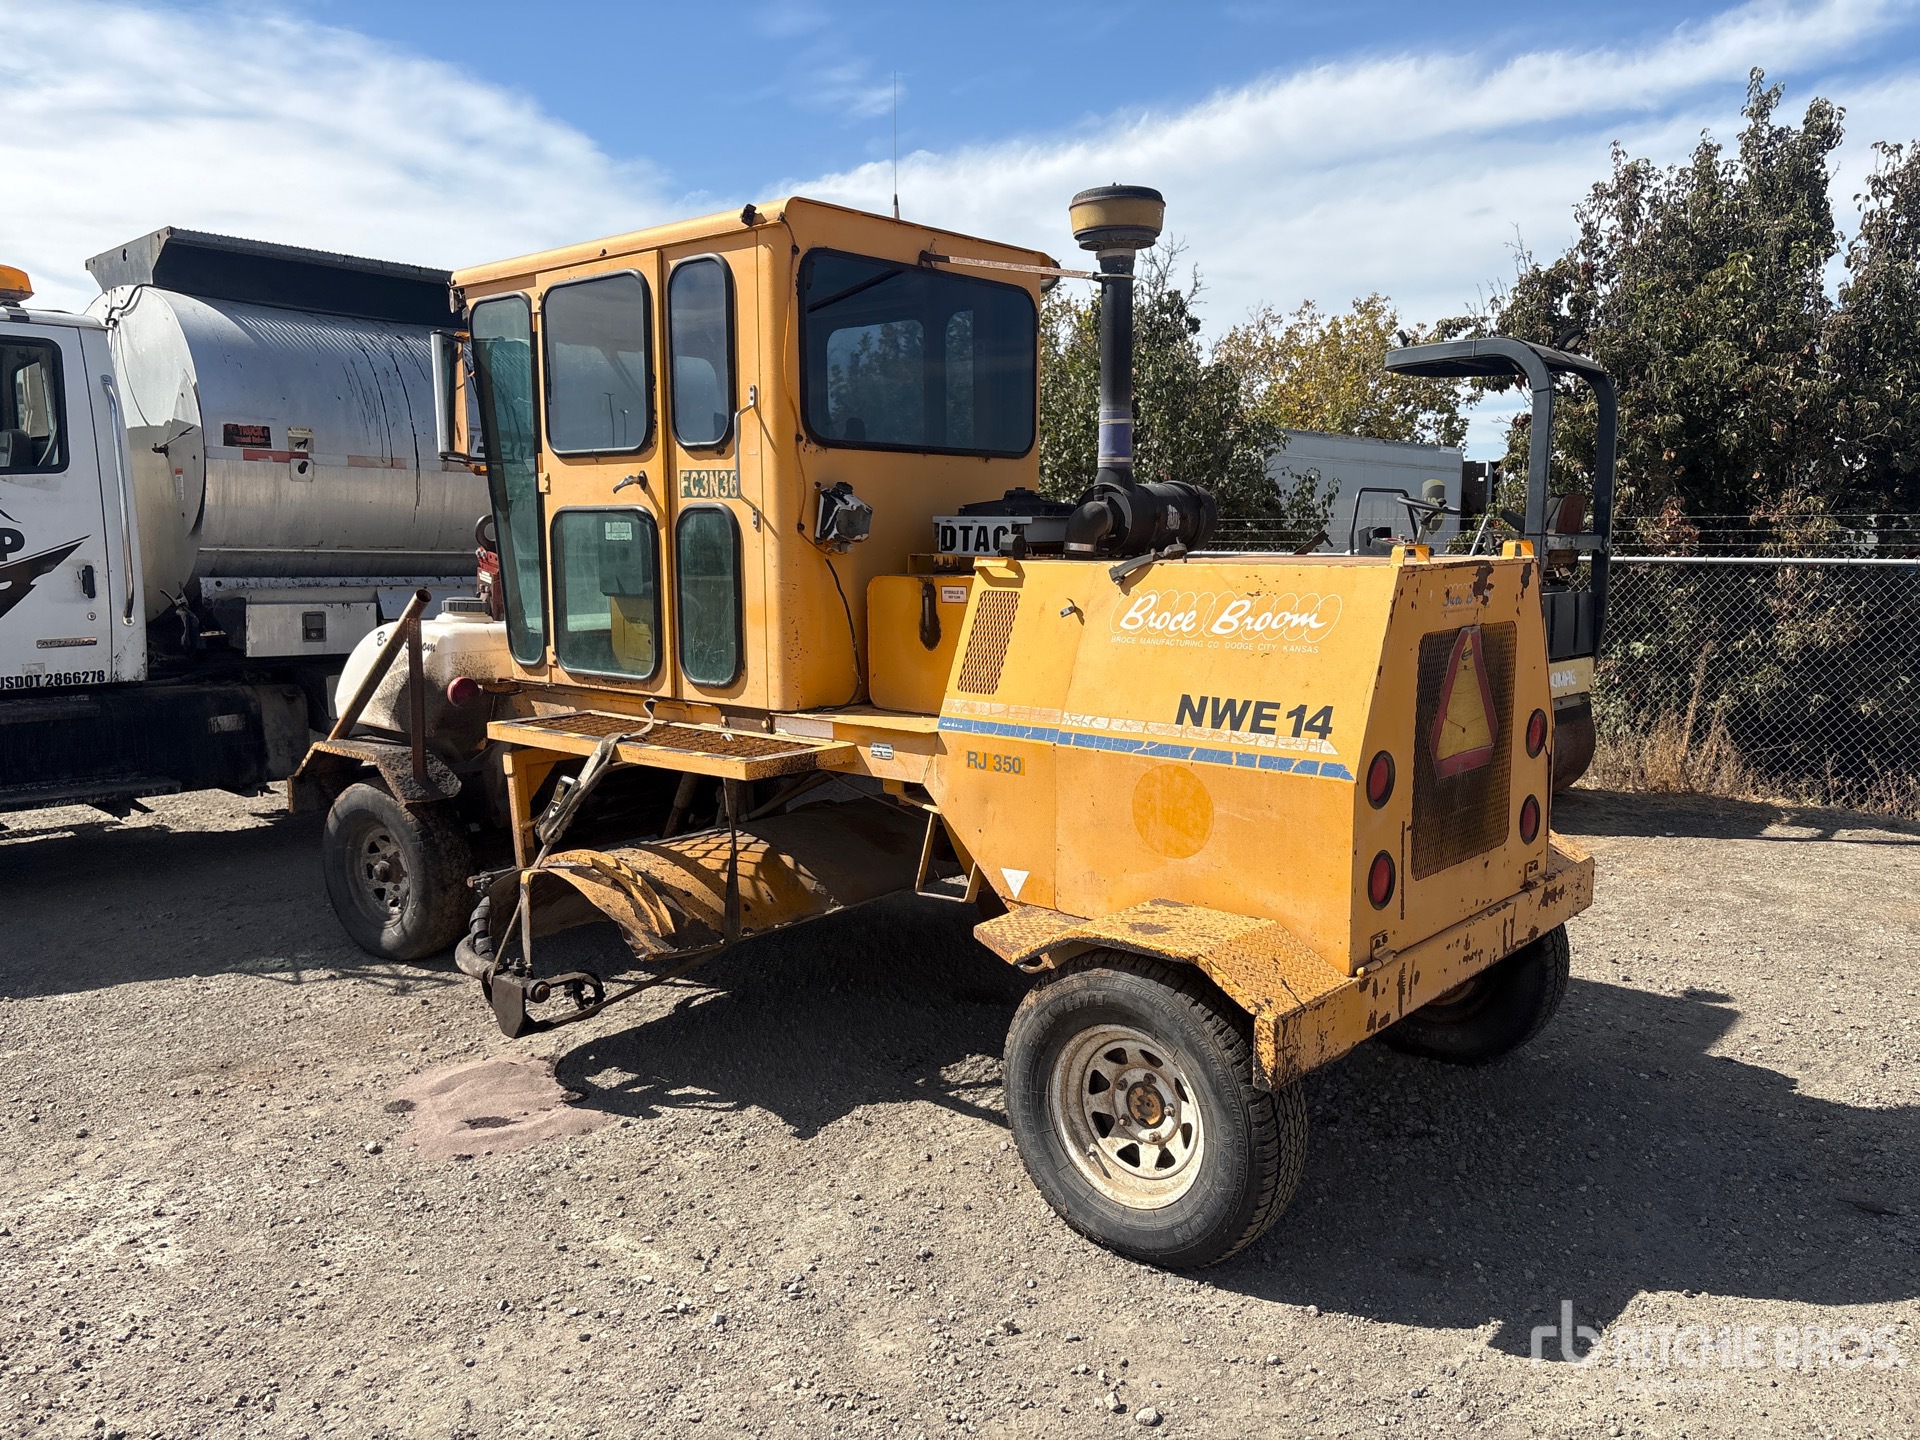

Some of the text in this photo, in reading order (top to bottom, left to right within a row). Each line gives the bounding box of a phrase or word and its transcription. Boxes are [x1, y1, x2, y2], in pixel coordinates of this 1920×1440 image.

[680, 470, 738, 498] FC3N36
[1119, 594, 1327, 635] Broce Broom
[1111, 635, 1137, 645] BROCE
[1140, 637, 1204, 648] MANUFACTURING
[1225, 641, 1254, 651] DODGE
[1282, 645, 1319, 654] KANSAS
[45, 669, 106, 688] 2866278
[1286, 703, 1334, 740] 14
[967, 751, 1022, 774] RJ 350
